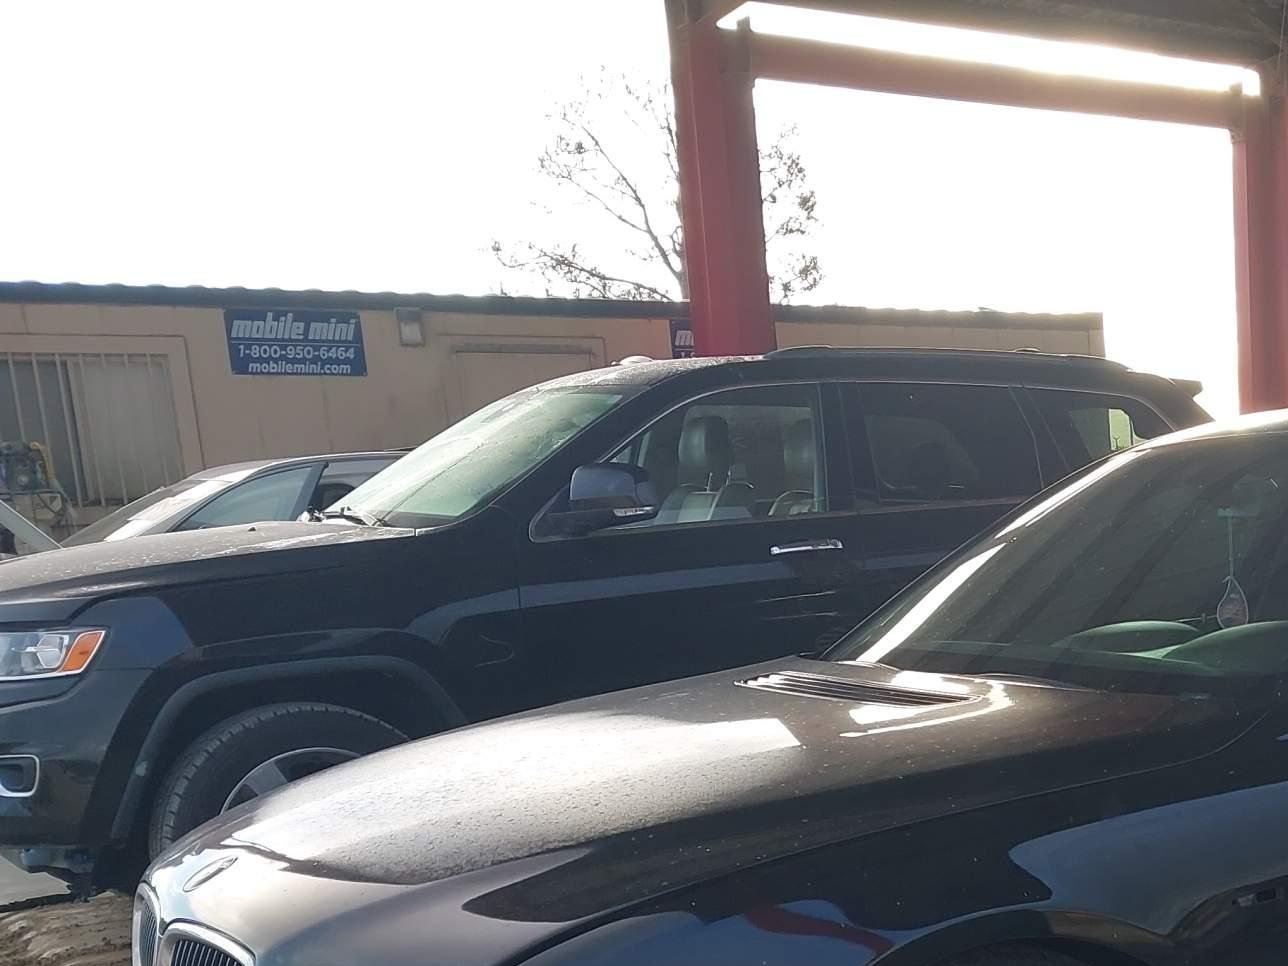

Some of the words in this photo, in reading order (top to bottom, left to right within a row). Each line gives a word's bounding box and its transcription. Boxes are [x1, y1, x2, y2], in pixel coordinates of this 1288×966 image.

[231, 312, 305, 339] mobile
[308, 318, 357, 340] mini
[238, 345, 355, 360] 1-800-950-6464
[248, 361, 351, 374] mobilemini.com
